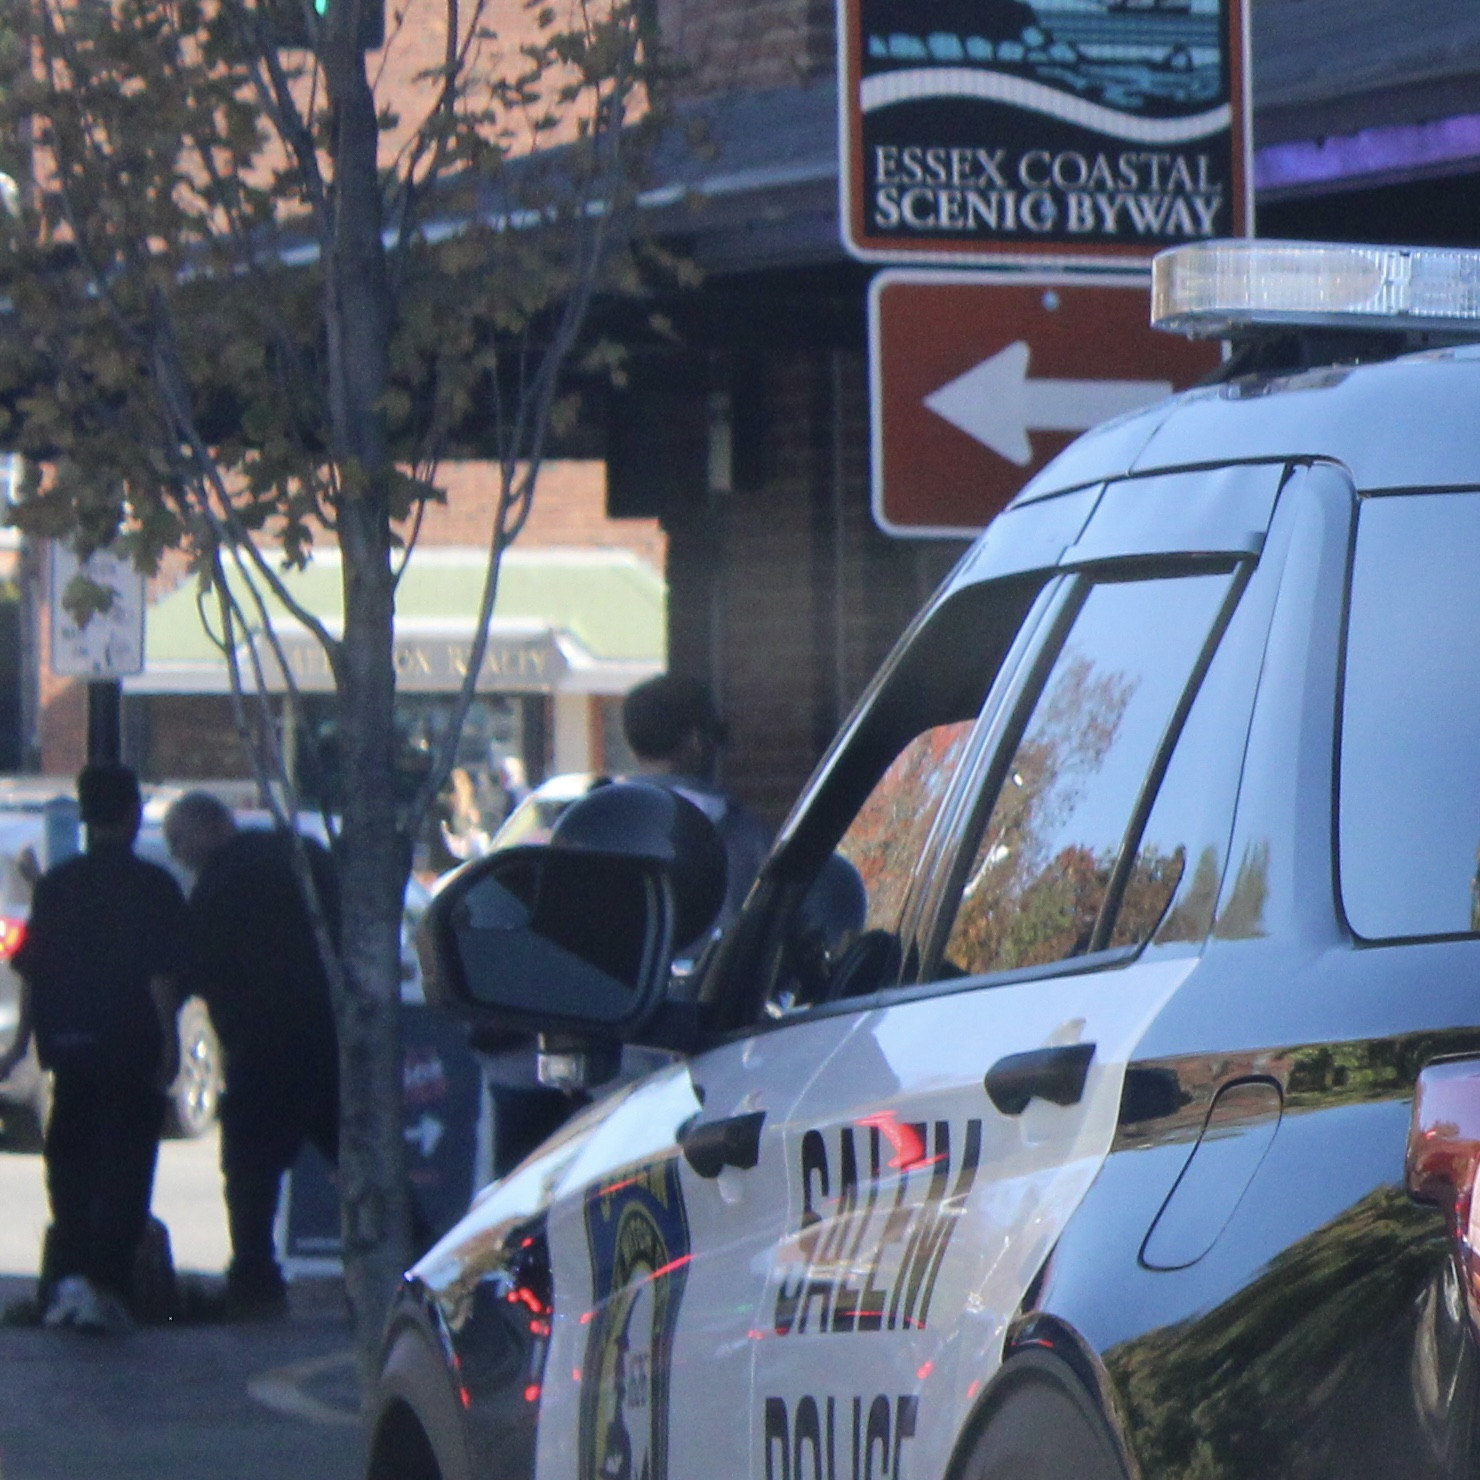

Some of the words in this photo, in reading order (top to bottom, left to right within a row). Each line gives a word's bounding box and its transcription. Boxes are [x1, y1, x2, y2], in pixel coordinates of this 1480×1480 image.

[875, 145, 1006, 188] ESSEX
[1018, 149, 1222, 193] COASTAL
[874, 187, 1056, 232] SCENIC
[1066, 191, 1222, 236] BYWAY
[775, 1120, 982, 1335] SALEM
